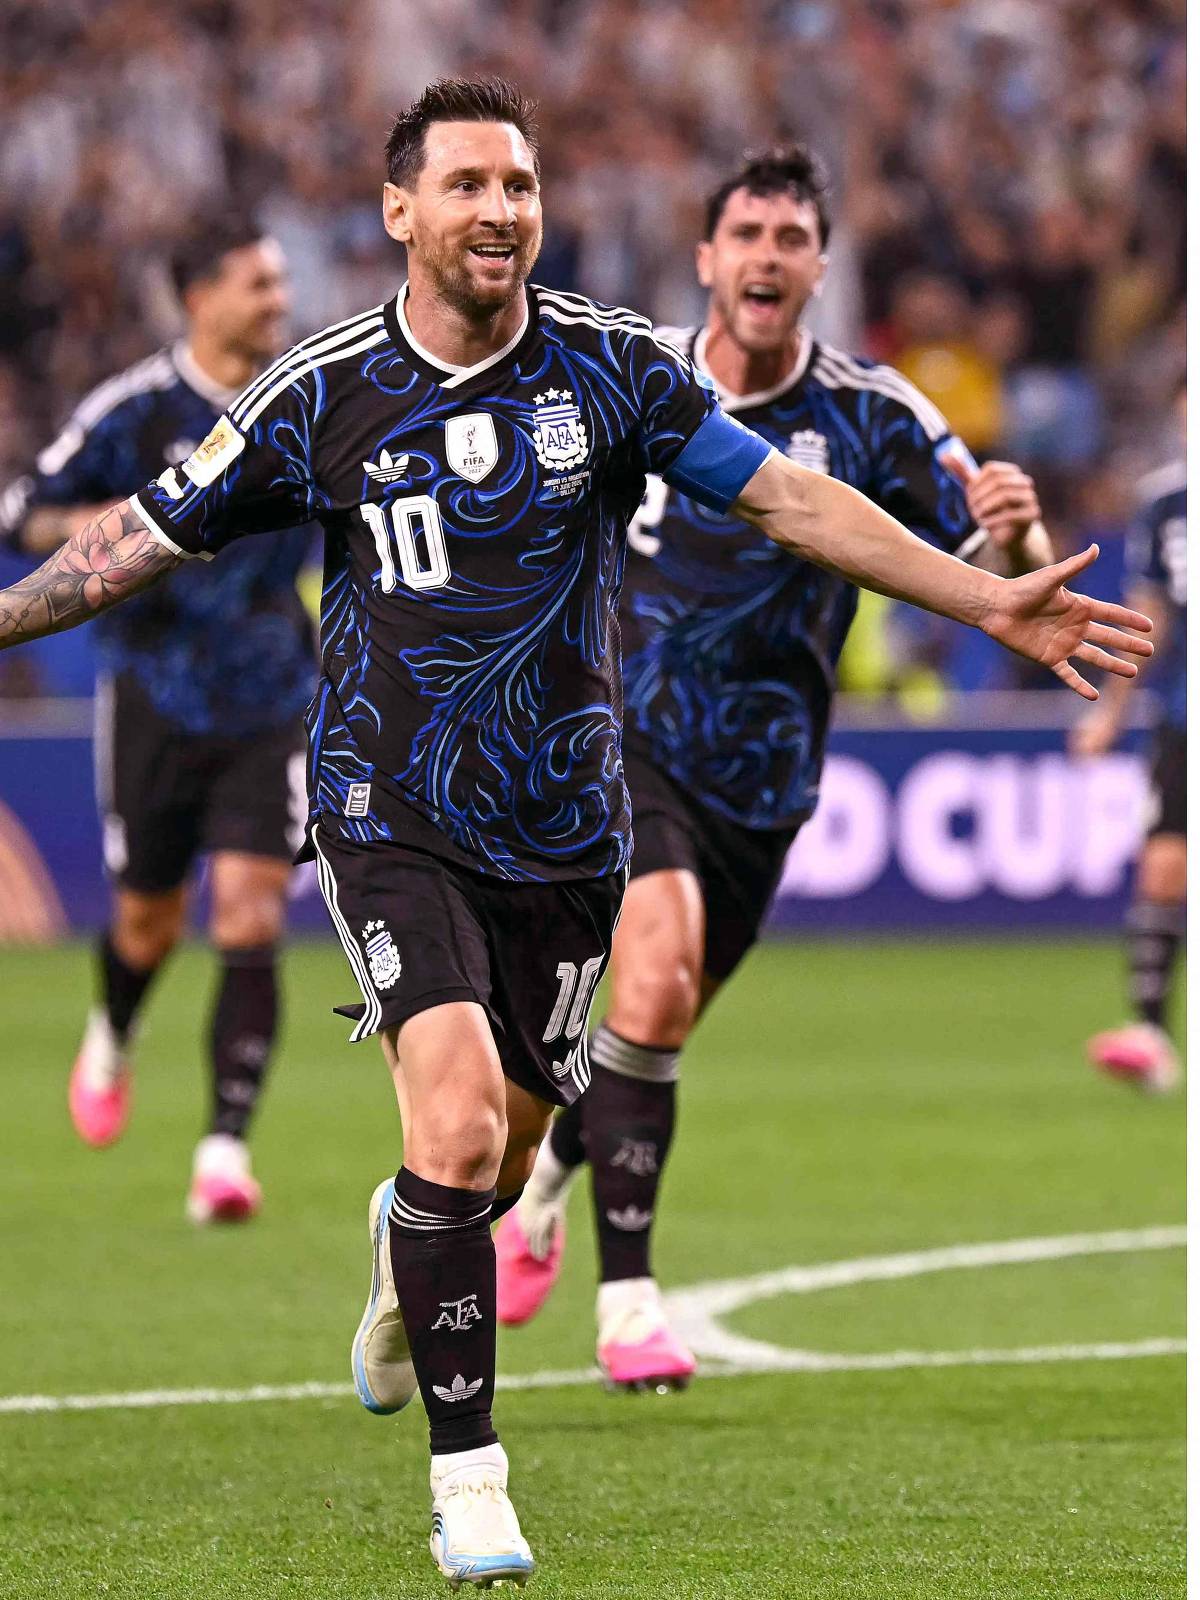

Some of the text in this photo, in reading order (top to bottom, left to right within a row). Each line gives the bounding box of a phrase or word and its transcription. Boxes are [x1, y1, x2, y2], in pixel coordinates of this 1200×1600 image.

[463, 456, 485, 466] FIFA
[547, 422, 576, 450] AFA
[359, 494, 452, 594] 10
[898, 752, 1152, 901] CUP
[542, 953, 605, 1043] 10
[431, 1294, 483, 1331] AFA
